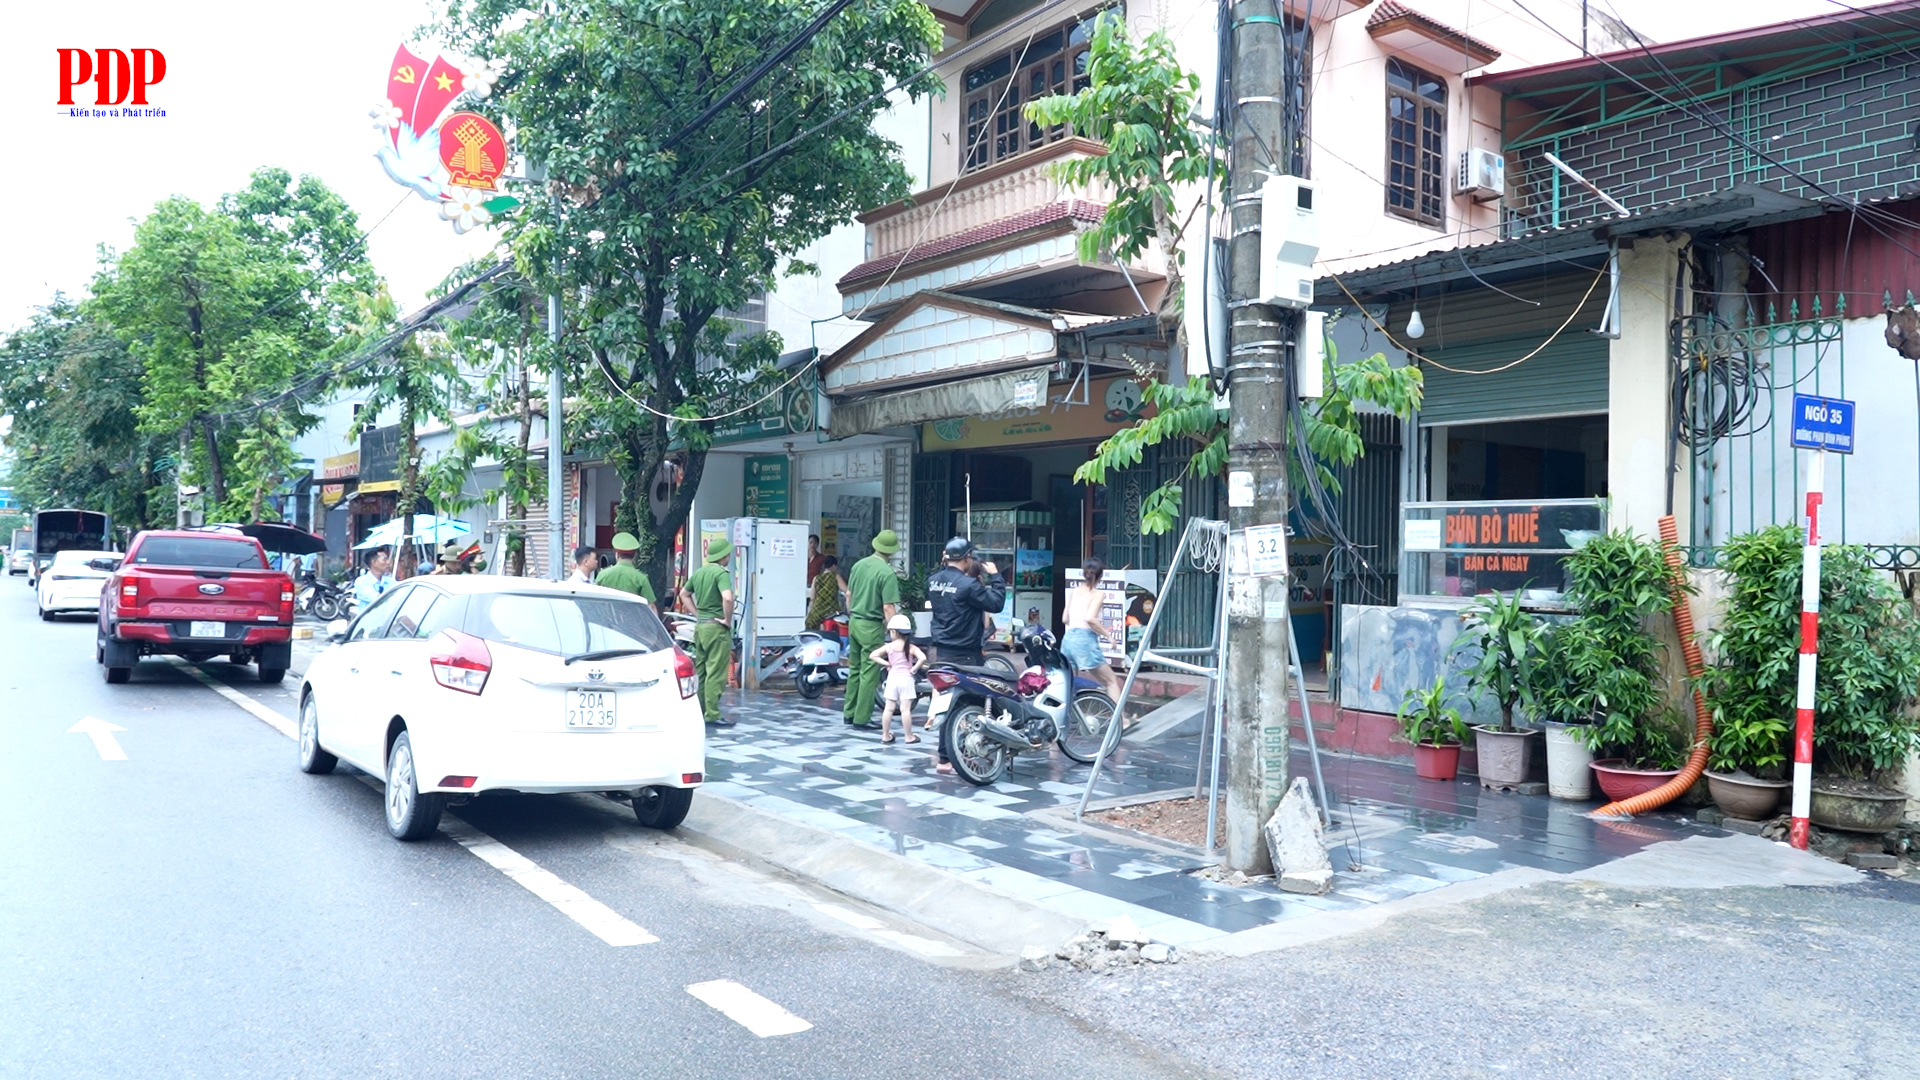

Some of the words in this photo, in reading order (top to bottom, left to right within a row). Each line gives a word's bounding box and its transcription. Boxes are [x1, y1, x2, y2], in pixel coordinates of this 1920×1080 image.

[1830, 409, 1843, 425] 35
[1446, 508, 1476, 544] BÚN
[1481, 507, 1502, 544] BÒ
[1507, 505, 1542, 543] HUẾ
[1257, 538, 1277, 554] 3.2
[579, 693, 604, 708] 20A
